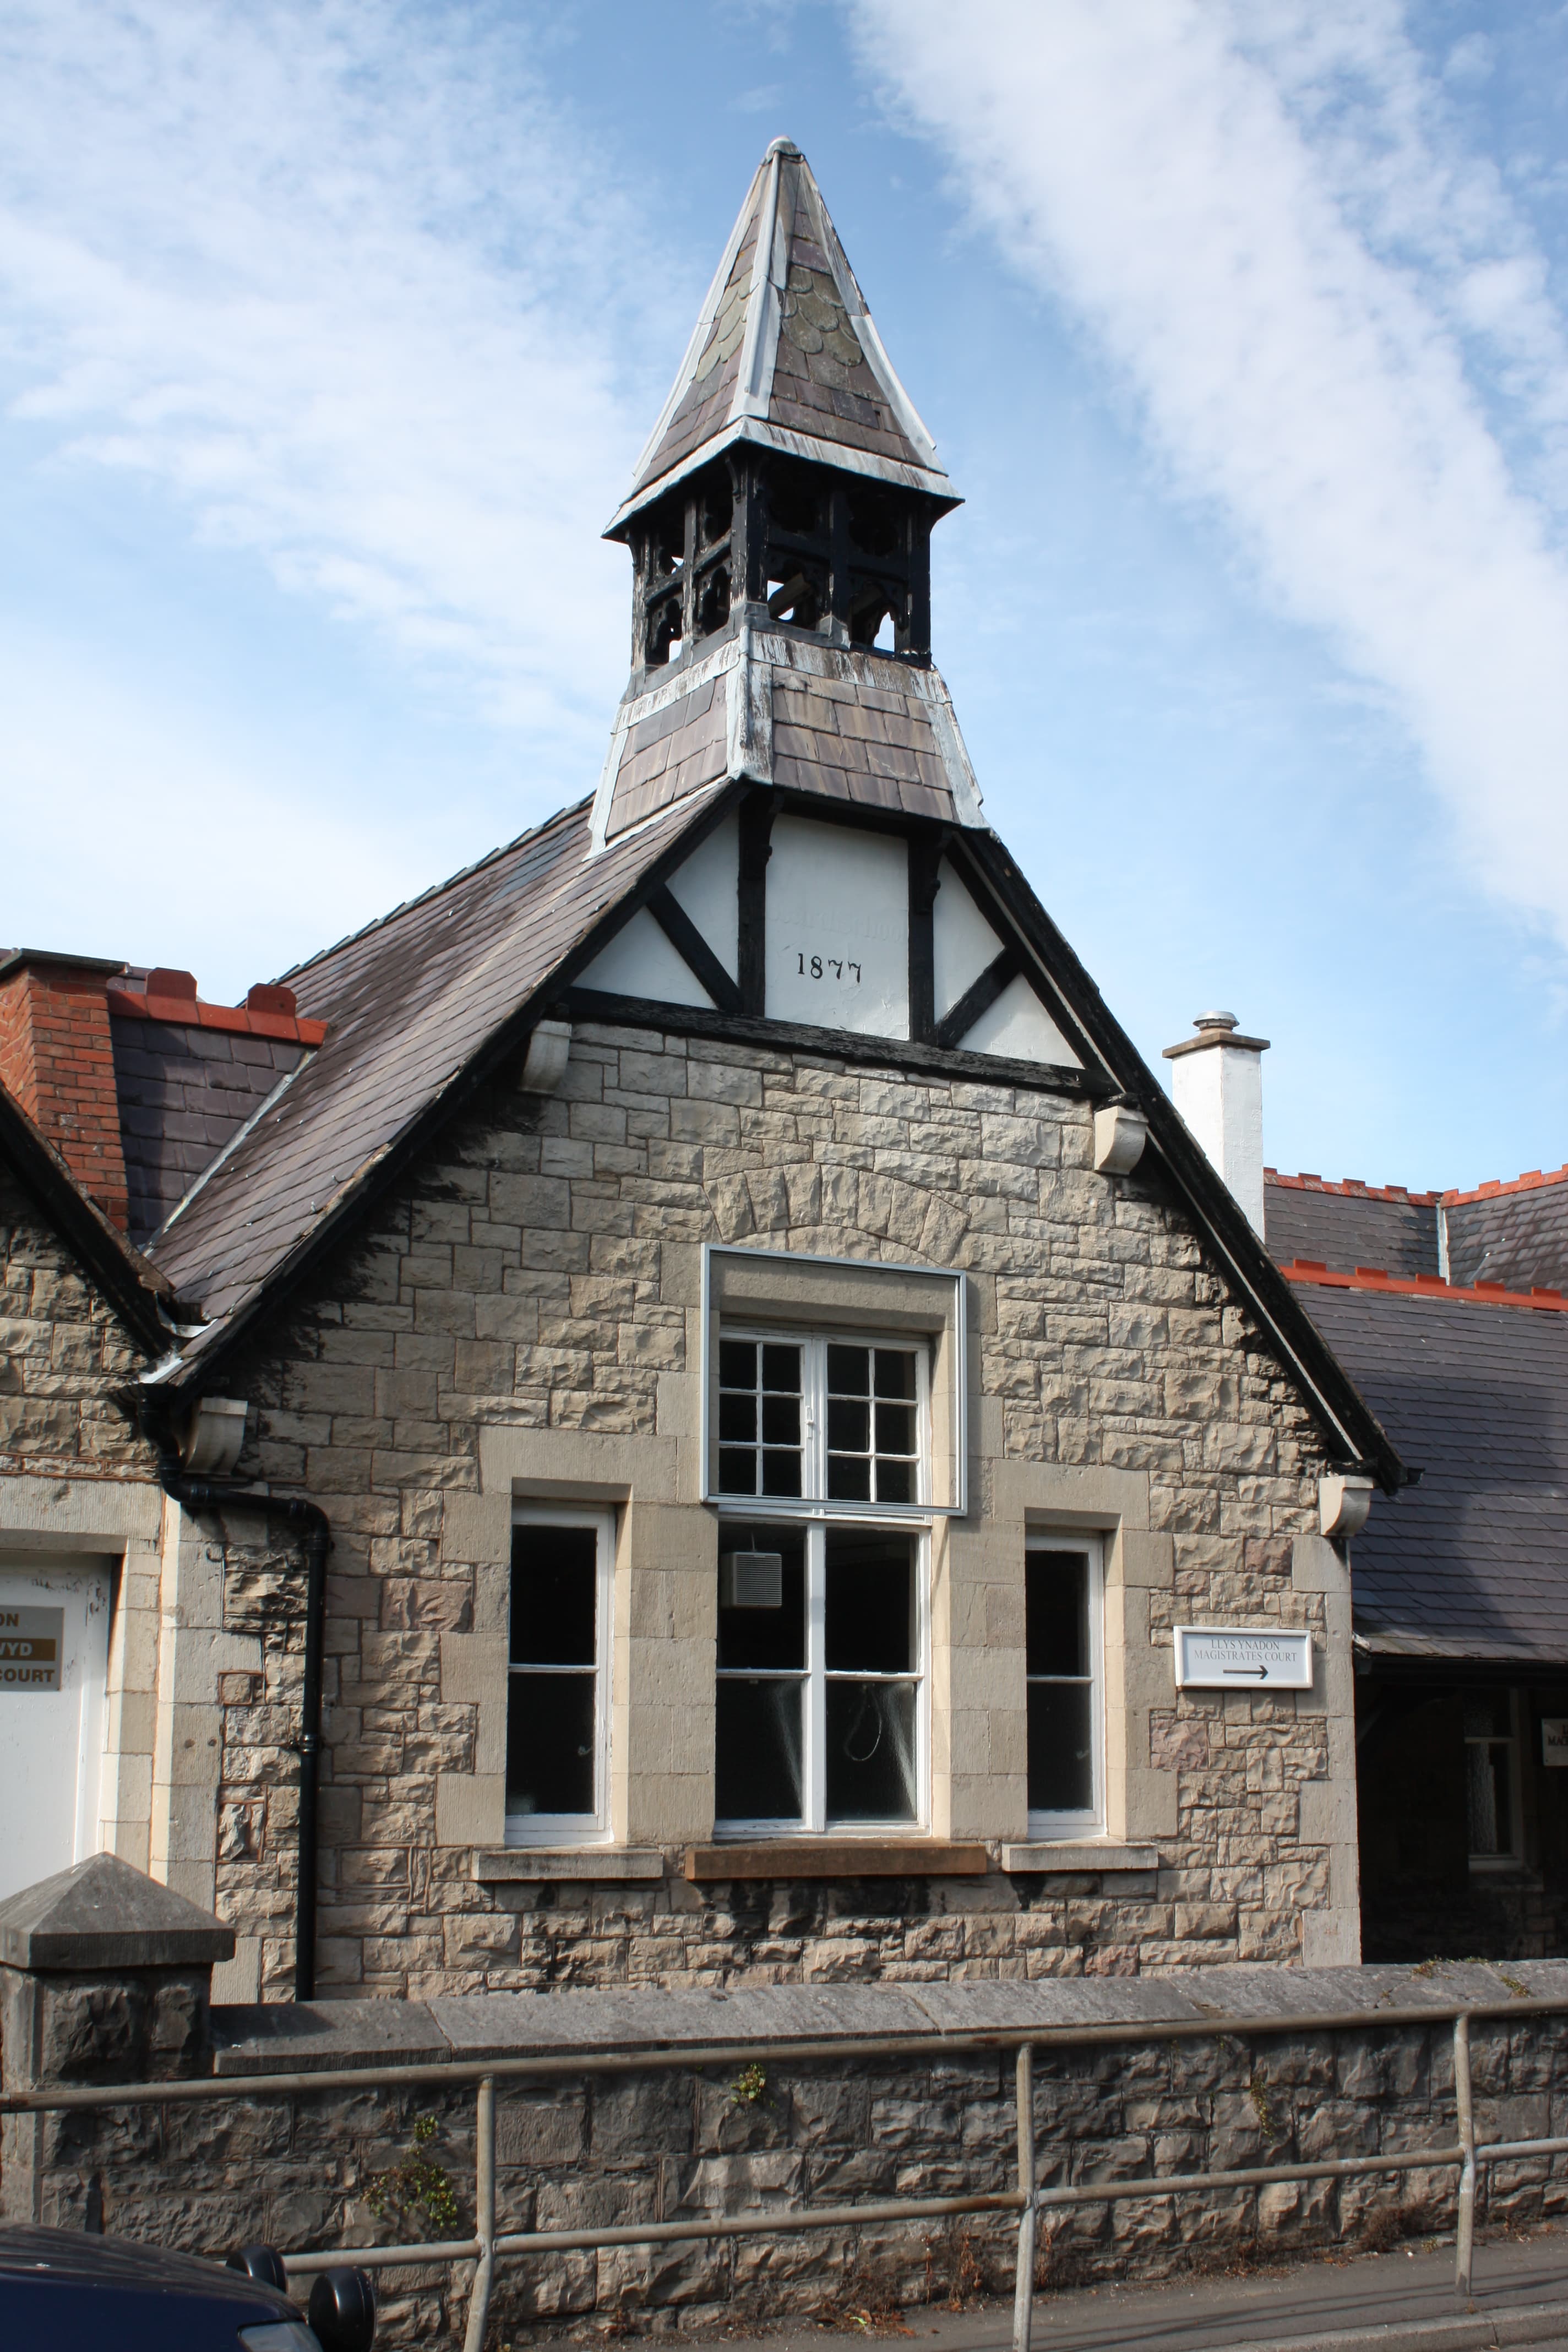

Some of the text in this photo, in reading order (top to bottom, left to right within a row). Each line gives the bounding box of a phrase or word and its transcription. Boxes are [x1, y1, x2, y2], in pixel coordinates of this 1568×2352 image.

[798, 953, 862, 983] 1877
[1211, 1639, 1280, 1651] LLYS YNADON
[1194, 1650, 1297, 1662] MAGISTRATES COURT
[0, 1668, 55, 1683] OURT
